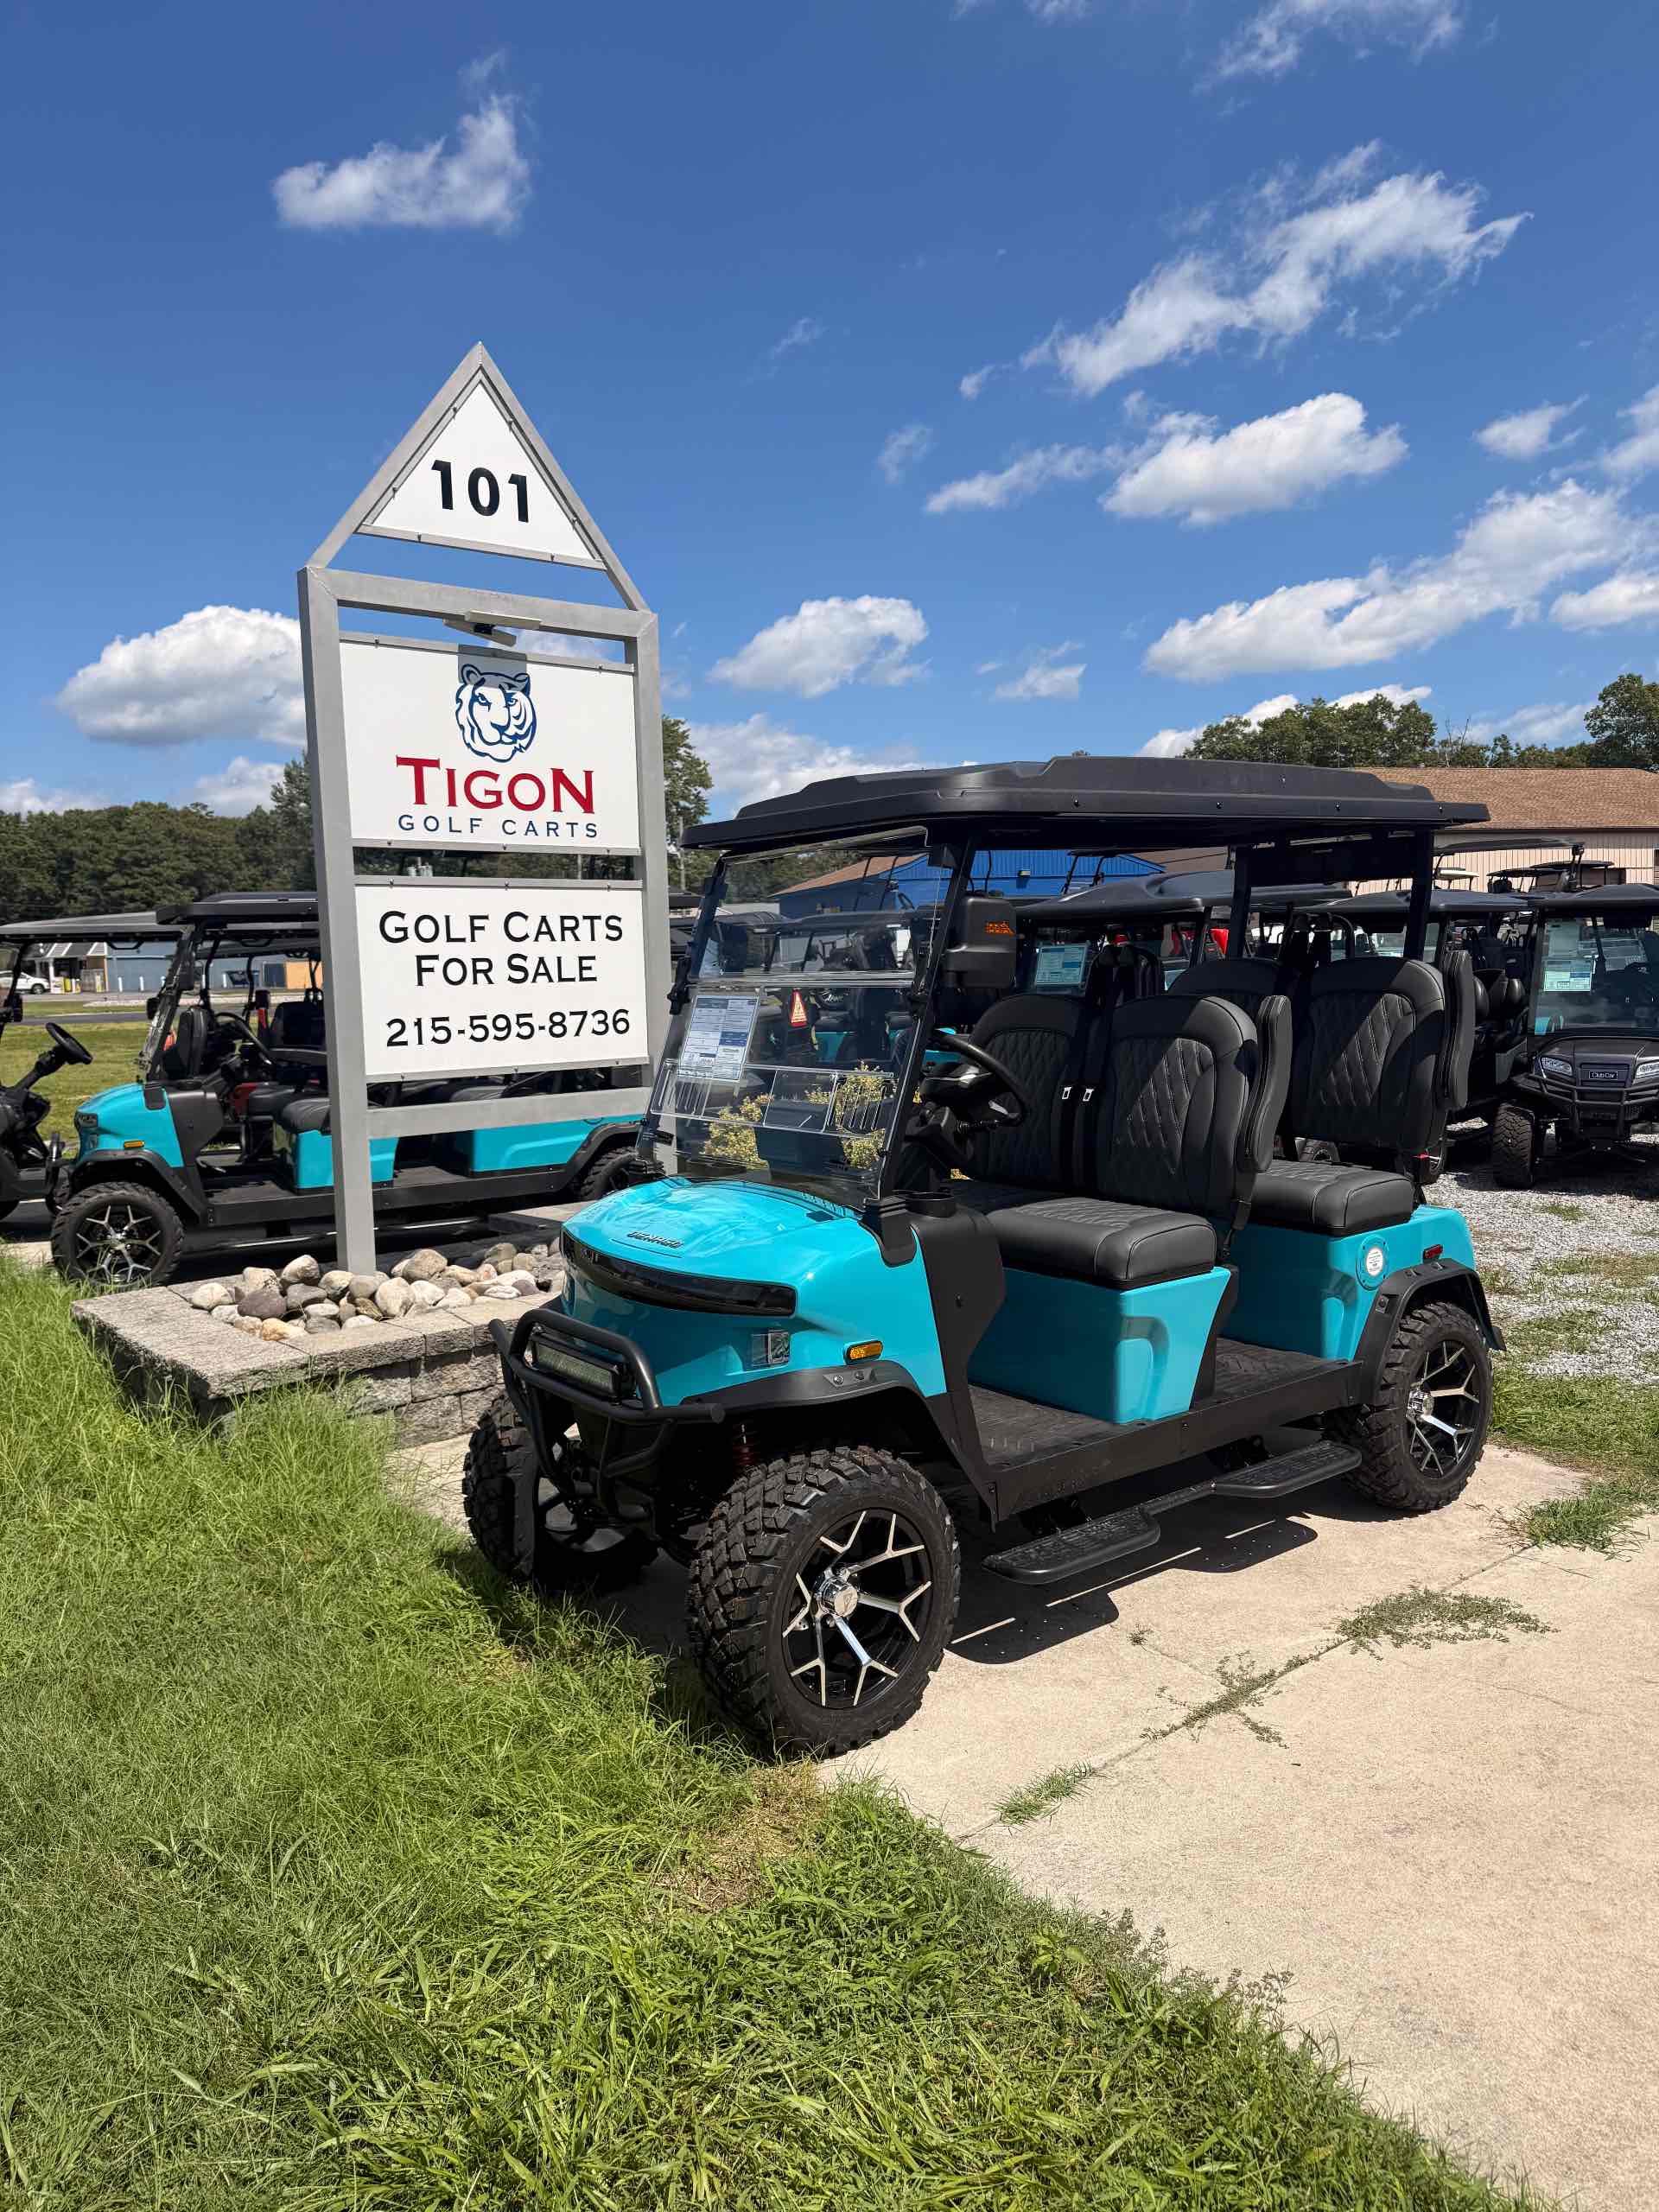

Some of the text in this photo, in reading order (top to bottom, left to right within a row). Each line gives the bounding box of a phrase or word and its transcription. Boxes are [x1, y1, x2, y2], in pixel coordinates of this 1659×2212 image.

[431, 459, 529, 524] 101
[395, 754, 595, 814] TIGON
[397, 814, 598, 838] GOLF CARTS
[378, 910, 624, 944] GOLF CARTS
[415, 952, 598, 987] FOR SALE
[386, 1008, 630, 1047] 215-595-8736
